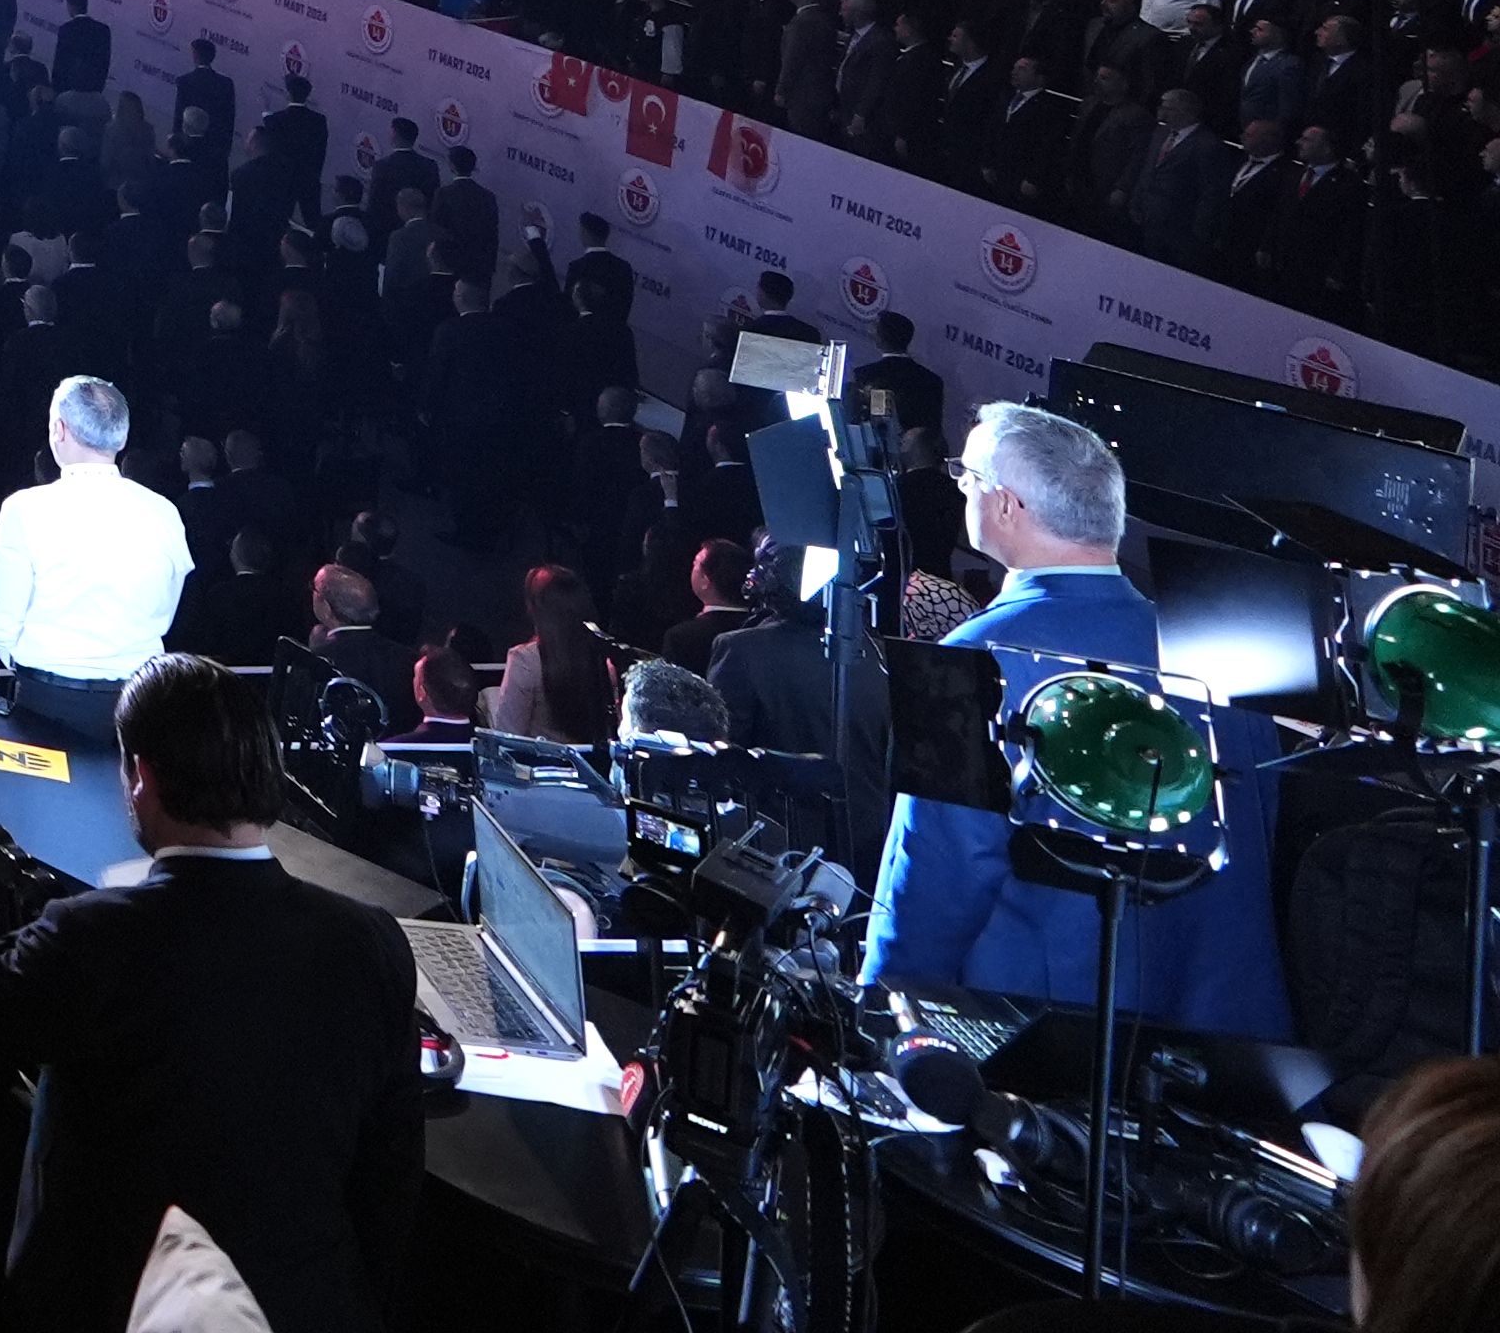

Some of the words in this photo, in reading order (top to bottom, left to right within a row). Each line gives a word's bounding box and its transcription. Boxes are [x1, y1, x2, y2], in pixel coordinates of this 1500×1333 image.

[307, 5, 328, 23] 2024
[428, 48, 437, 61] 17
[439, 52, 464, 72] MART
[466, 61, 491, 81] 2024
[341, 82, 349, 95] 17
[351, 86, 375, 105] MART
[376, 94, 399, 114] 2024
[507, 146, 517, 161] 17
[519, 151, 547, 173] MART
[548, 162, 575, 184] 2024
[831, 193, 844, 210] 17
[849, 199, 883, 226] MART
[886, 214, 922, 241] 2024
[705, 225, 716, 240] 17
[719, 230, 751, 257] MART
[754, 245, 788, 270] 2024
[640, 273, 671, 299] 2024
[1098, 294, 1114, 314] 17
[1118, 301, 1164, 332] MART
[1166, 320, 1212, 352] 2024
[945, 324, 959, 342] 17
[962, 329, 1003, 361] MART
[1004, 349, 1045, 379] 2024
[1467, 434, 1500, 464] MA
